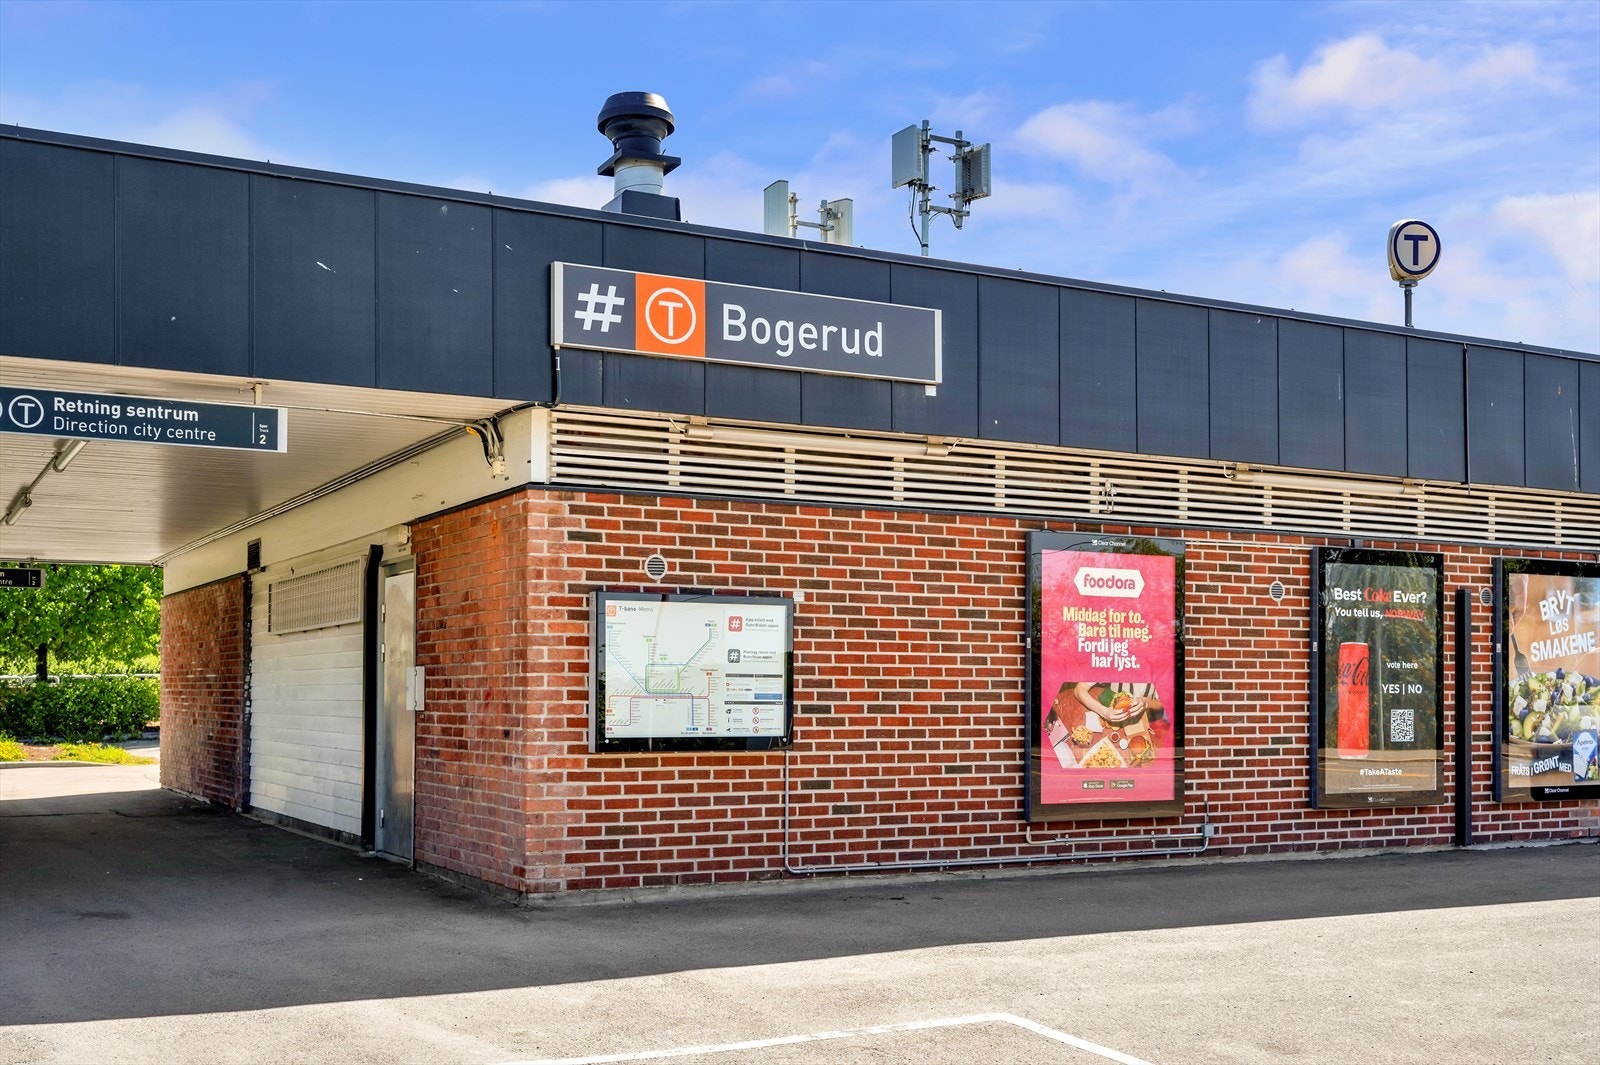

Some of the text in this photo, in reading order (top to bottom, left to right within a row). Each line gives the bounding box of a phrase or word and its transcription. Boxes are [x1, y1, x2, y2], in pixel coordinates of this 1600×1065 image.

[722, 303, 883, 358] Bogerud
[54, 398, 121, 419] Retning
[126, 406, 199, 422] sentrum
[54, 417, 216, 441] Direction city centre
[260, 434, 266, 444] 2
[1084, 574, 1136, 590] foodora
[1334, 588, 1427, 604] Best Coke Ever?
[1335, 608, 1383, 619] You tell us,
[1539, 590, 1574, 621] BRYT
[1062, 606, 1145, 626] Middag for to.
[1078, 623, 1152, 642] Bare til meg.
[1549, 617, 1569, 635] LØS
[1078, 638, 1129, 656] Fordi jeg
[1530, 632, 1596, 662] SMAKENE
[1092, 653, 1140, 671] har lyst.
[1382, 684, 1400, 694] YES
[1408, 684, 1422, 694] NO
[1360, 768, 1402, 776] #TakeATaste
[1511, 764, 1530, 776] FRÅTS
[1534, 756, 1559, 774] GRØNT
[1559, 762, 1572, 773] MED
